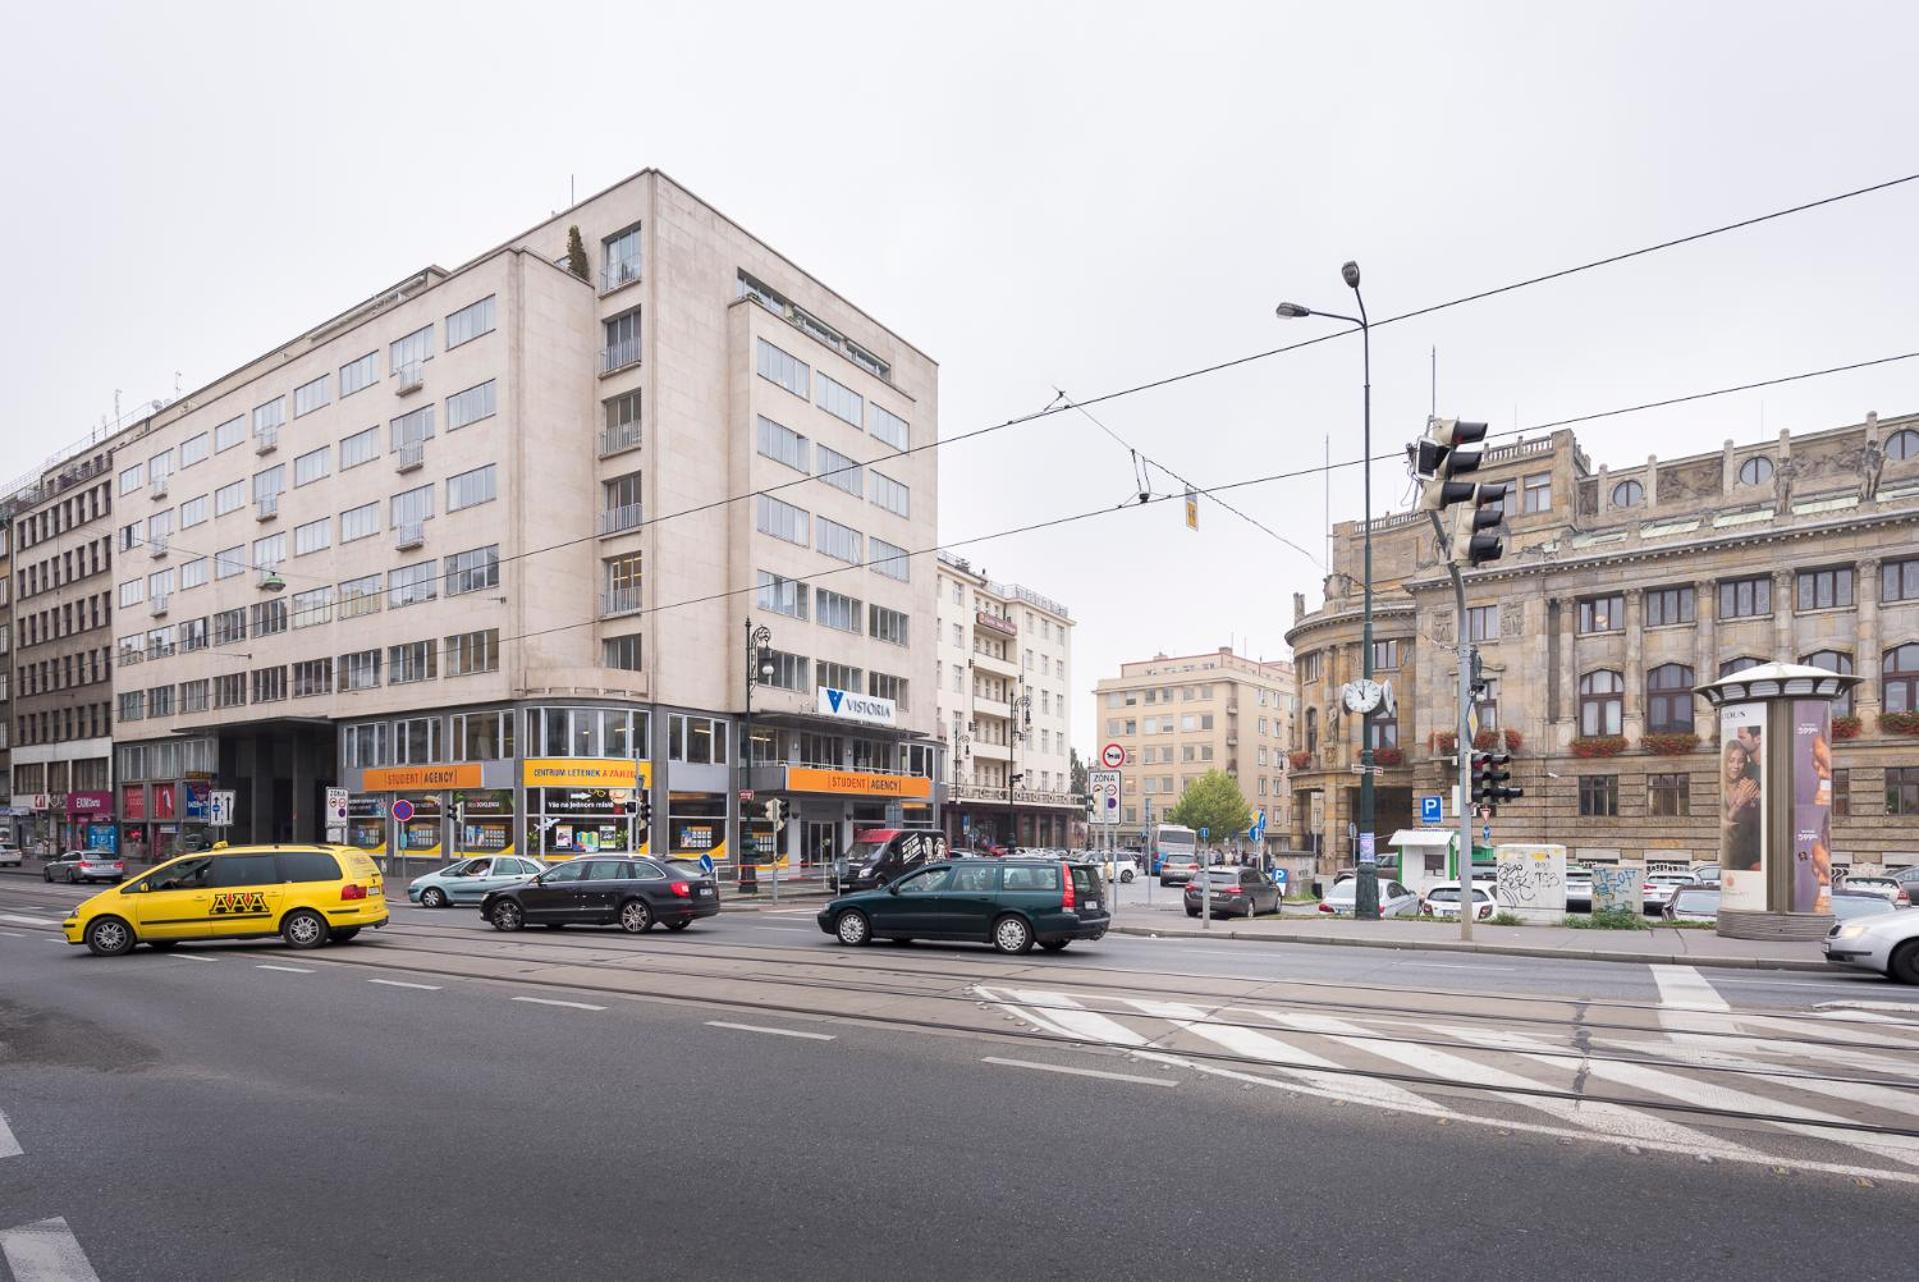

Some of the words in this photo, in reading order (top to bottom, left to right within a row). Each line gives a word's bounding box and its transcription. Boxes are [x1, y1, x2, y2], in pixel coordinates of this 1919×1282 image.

[846, 699, 891, 718] VISTORIA
[387, 772, 418, 785] STUDENT
[423, 771, 454, 783] AGENCY
[534, 768, 565, 777] CENTRUM
[567, 768, 601, 777] LETENEK
[831, 777, 866, 789] STUDENT
[870, 780, 898, 791] AGENCY
[1424, 799, 1437, 814] P
[209, 892, 270, 914] AAA
